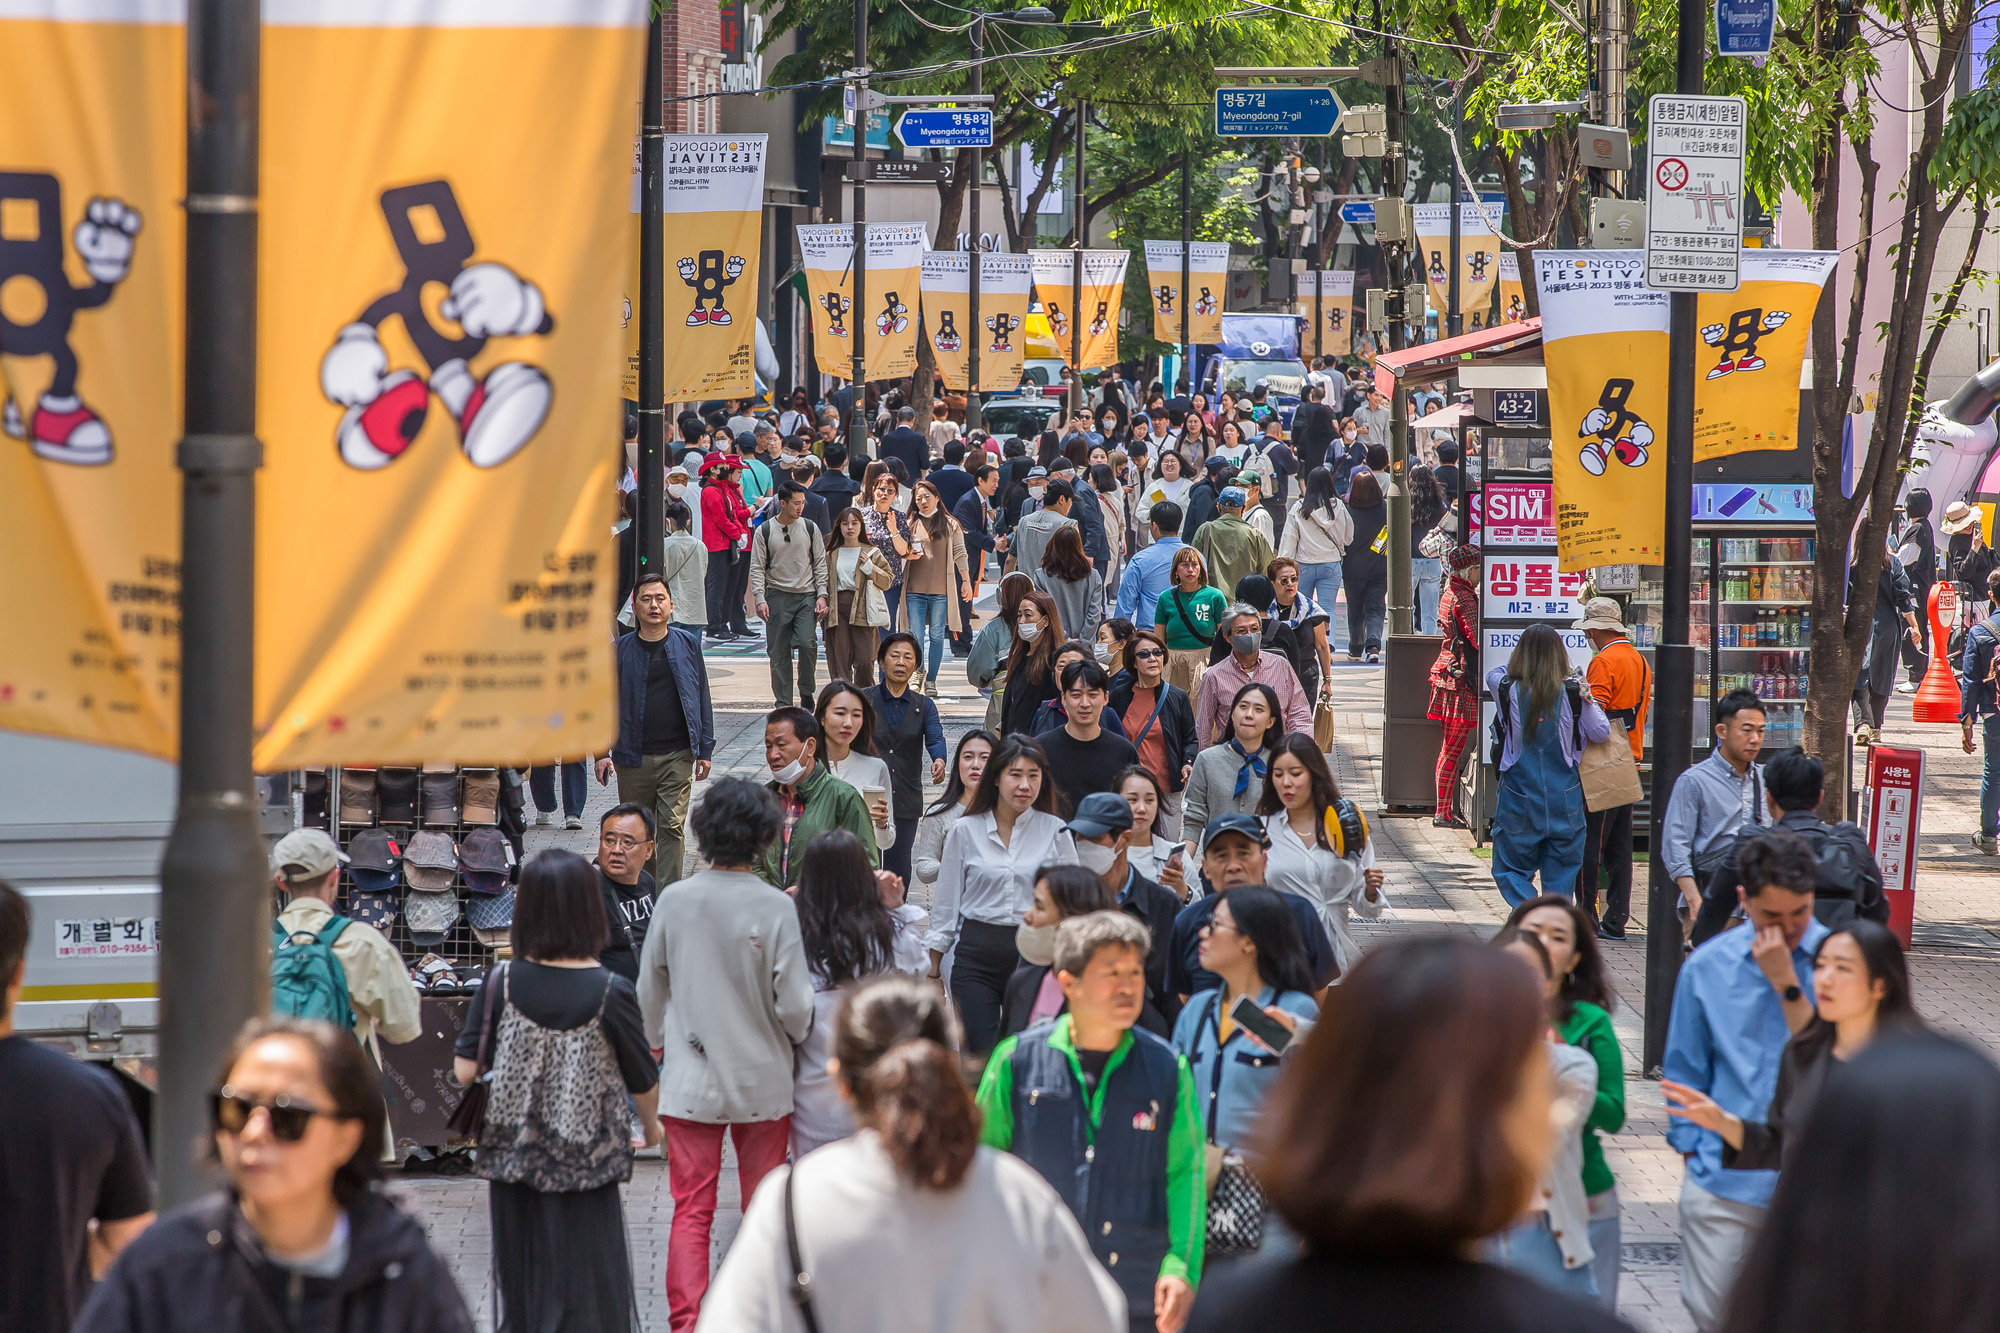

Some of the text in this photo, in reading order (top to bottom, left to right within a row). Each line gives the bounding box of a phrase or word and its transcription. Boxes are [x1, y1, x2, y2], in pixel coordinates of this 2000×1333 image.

[1223, 92, 1266, 108] 명동7길
[1222, 111, 1302, 121] Myeongdong 7-gil
[1657, 102, 1740, 123] 통행금지(제한)알림
[952, 113, 989, 126] 명동8길
[920, 127, 989, 137] Myeongdong 8-gil
[1709, 128, 1738, 140] 모든차량
[1653, 235, 1668, 246] 구간
[1673, 237, 1719, 248] 명동관광특구
[1720, 238, 1735, 249] 일대
[1542, 260, 1645, 269] MYEONGDO
[1659, 272, 1726, 284] 남대문경찰서장
[1544, 281, 1588, 293] 서울페스타
[1589, 281, 1613, 289] 2023
[1613, 281, 1631, 289] 명동
[1499, 399, 1533, 414] 43-2
[1488, 494, 1543, 520] SIM
[1508, 602, 1533, 614] 사고
[1545, 602, 1569, 614] 팔고
[1490, 634, 1519, 648] BES
[1883, 766, 1912, 779] 사용법
